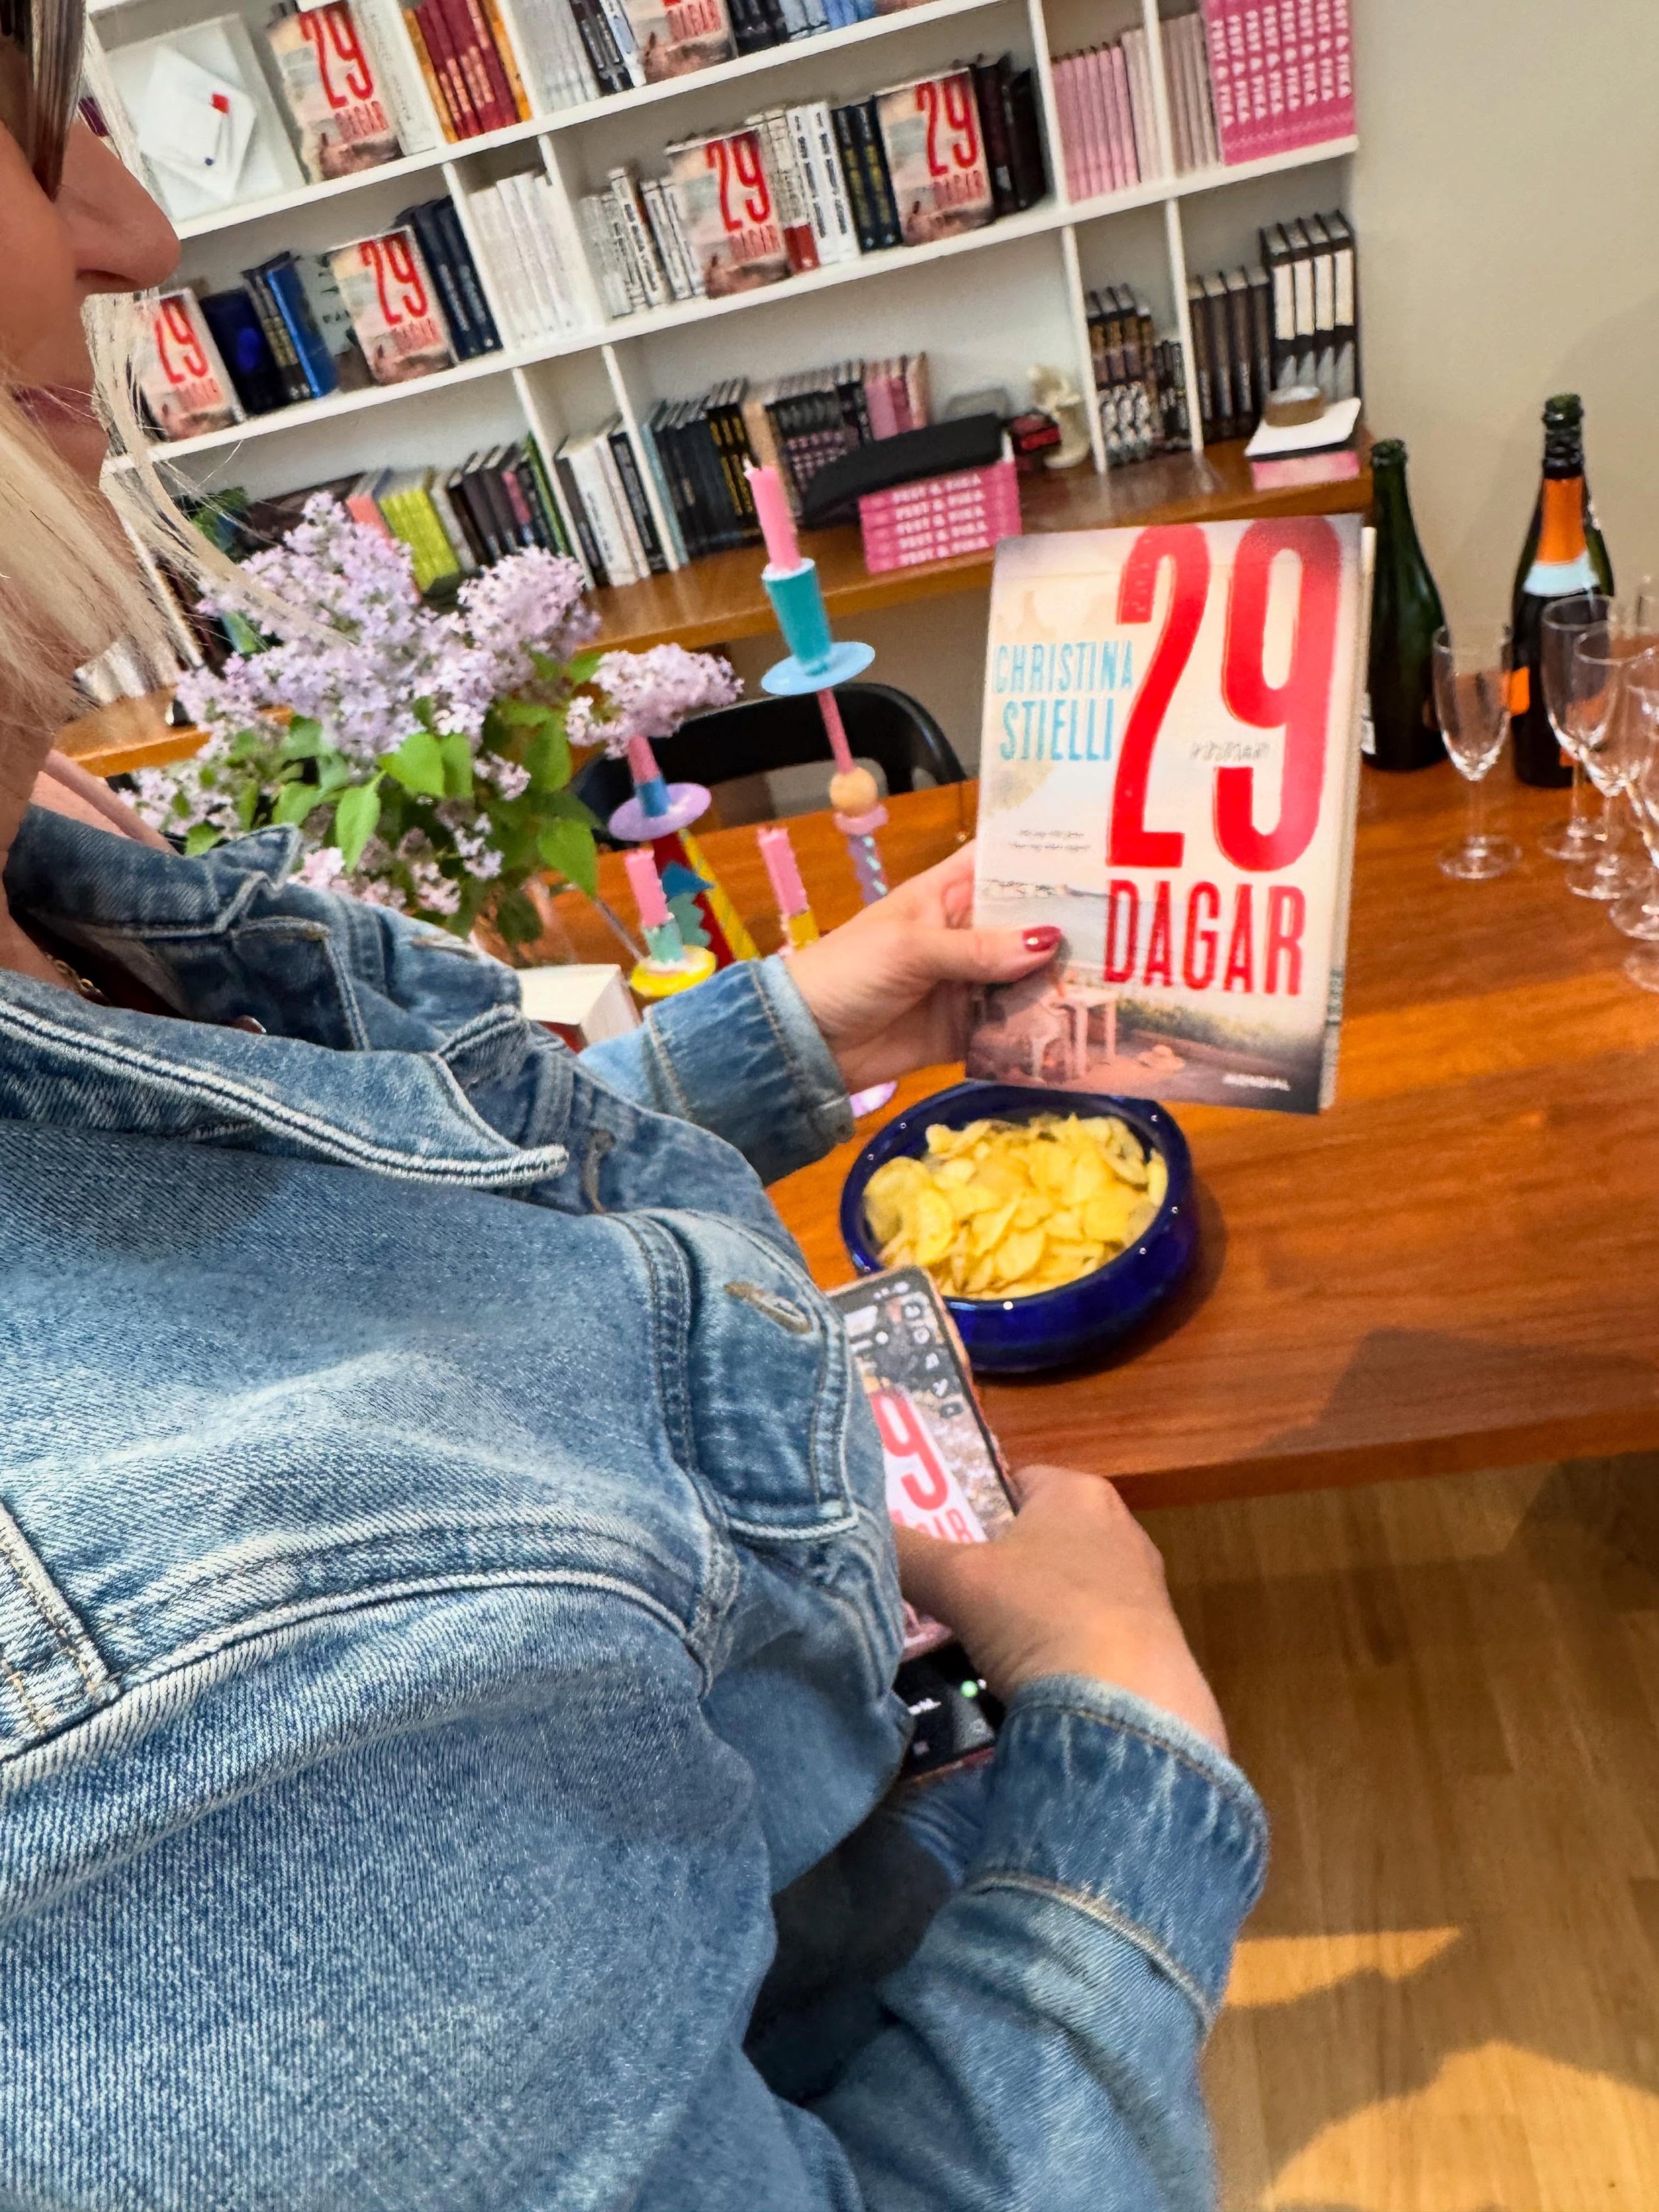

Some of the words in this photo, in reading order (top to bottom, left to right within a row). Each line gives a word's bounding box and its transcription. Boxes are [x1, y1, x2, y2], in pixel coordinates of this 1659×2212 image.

[299, 3, 374, 108] 29
[916, 73, 977, 177] 29
[705, 131, 770, 232] 29
[358, 232, 427, 325] 29
[155, 297, 208, 384] 29
[993, 640, 1133, 694] CHRISTINA
[1107, 516, 1342, 872] 29
[1000, 699, 1114, 761] STIELLI
[1104, 879, 1306, 995] DAGAR
